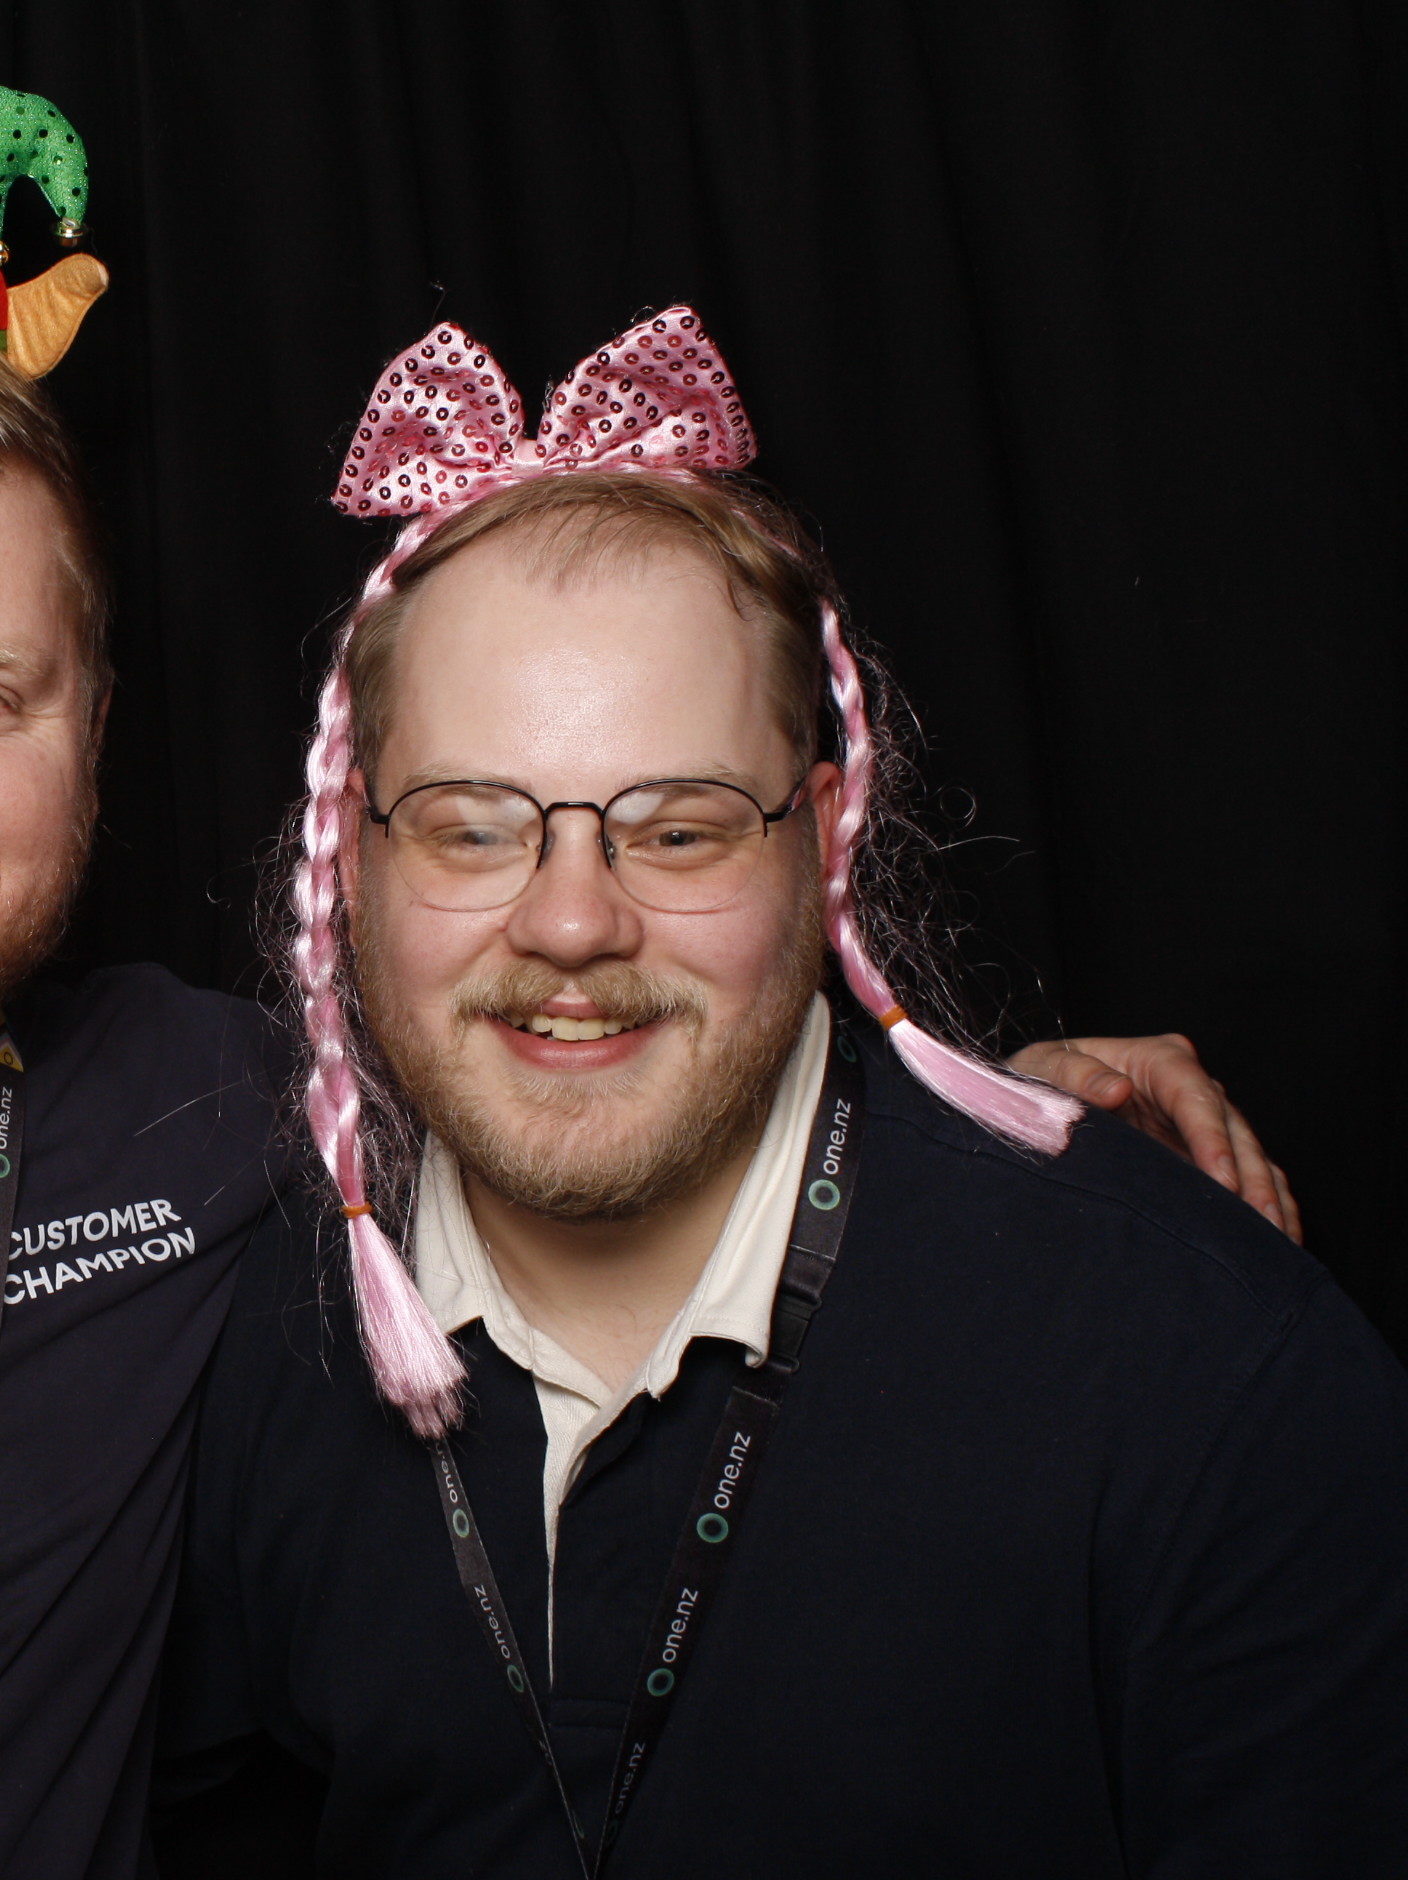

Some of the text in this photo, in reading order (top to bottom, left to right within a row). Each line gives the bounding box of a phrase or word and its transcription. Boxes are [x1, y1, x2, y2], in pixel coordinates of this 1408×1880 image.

[822, 1097, 852, 1176] one.nz
[3, 1226, 196, 1305] CHAMPION
[8, 1199, 182, 1261] CUSTOMER
[713, 1431, 751, 1510] one.nz
[474, 1584, 511, 1660] one.nz
[662, 1587, 699, 1664] one.nz
[614, 1742, 646, 1815] one.nz
